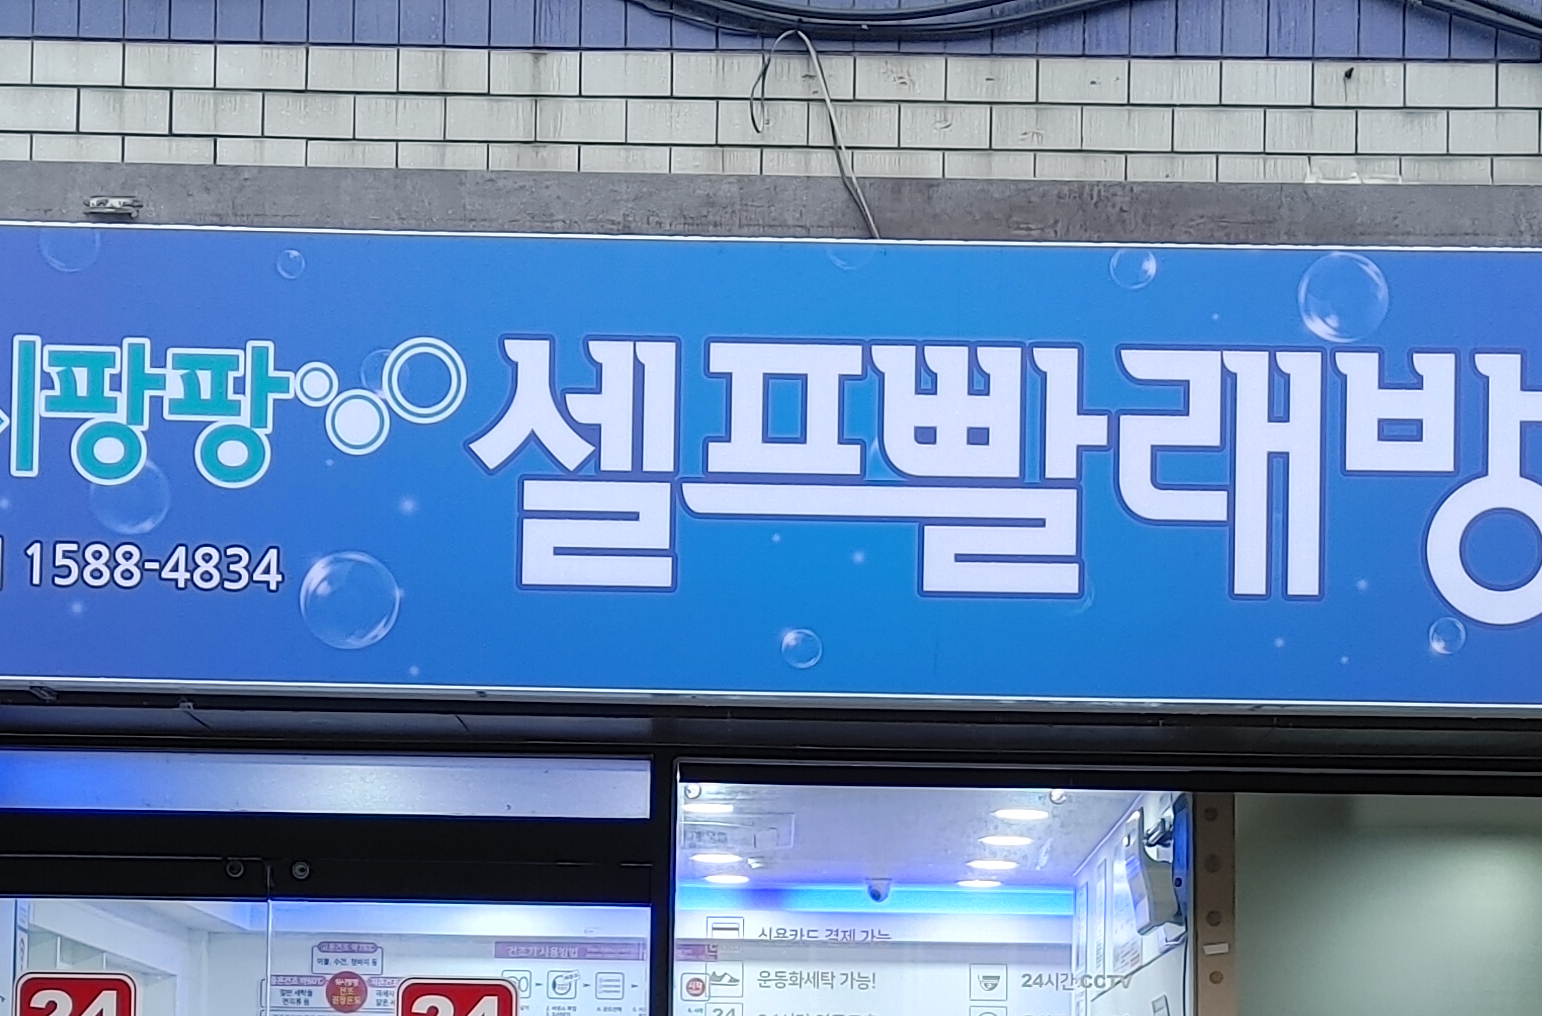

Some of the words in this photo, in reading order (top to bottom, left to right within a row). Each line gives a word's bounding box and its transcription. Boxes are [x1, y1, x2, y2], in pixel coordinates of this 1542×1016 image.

[22, 538, 285, 593] 1588-4834
[757, 970, 837, 990] 운동화세탁
[839, 971, 877, 991] 가능!
[1020, 972, 1075, 991] 24시간
[1079, 973, 1134, 990] CCTV
